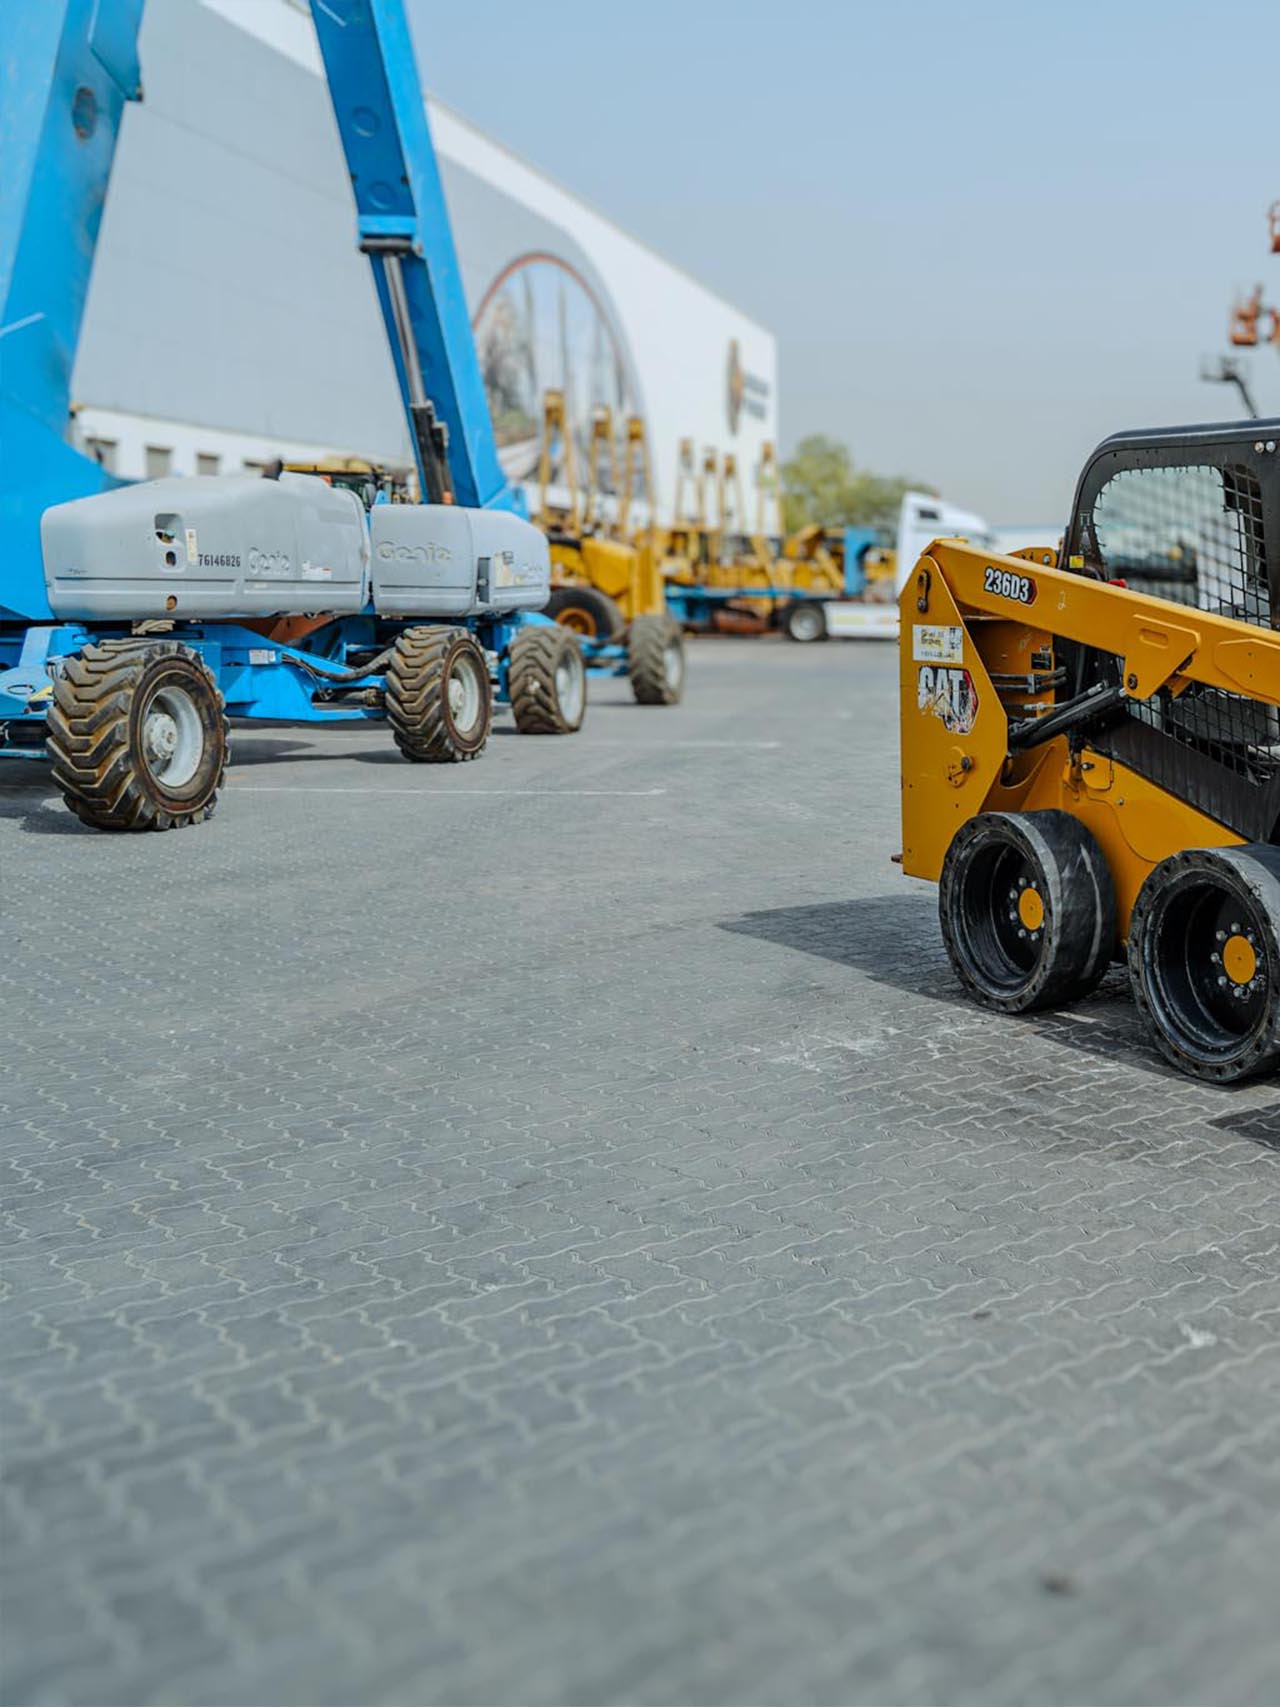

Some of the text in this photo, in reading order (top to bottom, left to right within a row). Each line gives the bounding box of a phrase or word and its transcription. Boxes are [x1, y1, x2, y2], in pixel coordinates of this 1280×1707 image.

[376, 540, 452, 564] Genie
[984, 568, 1030, 602] 236D3
[918, 666, 964, 712] CAT
